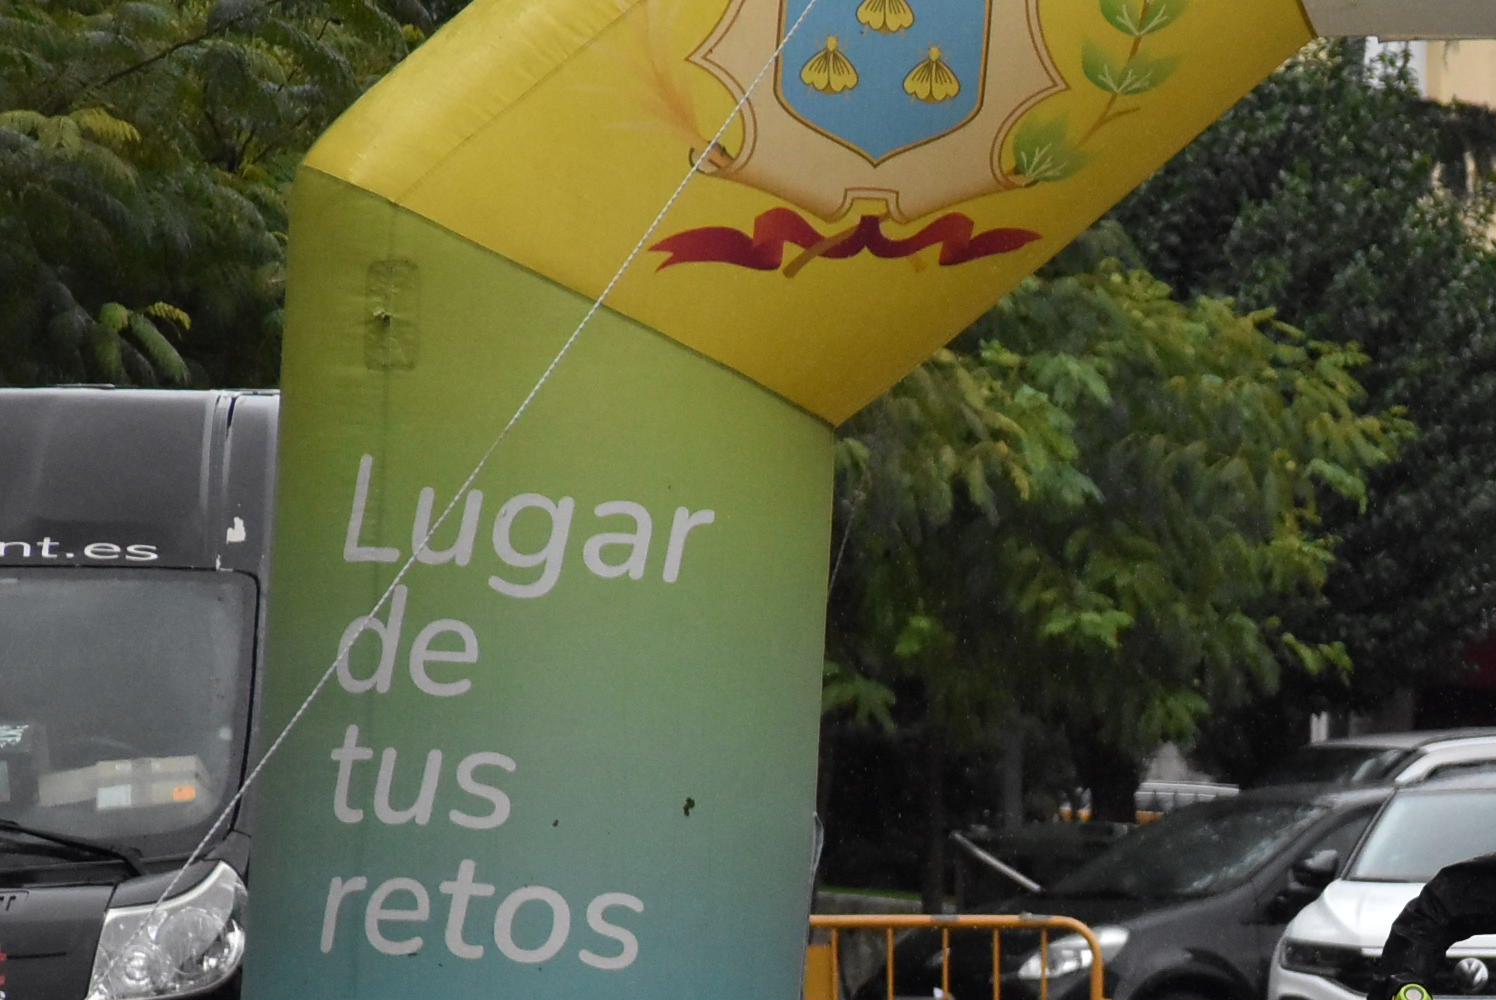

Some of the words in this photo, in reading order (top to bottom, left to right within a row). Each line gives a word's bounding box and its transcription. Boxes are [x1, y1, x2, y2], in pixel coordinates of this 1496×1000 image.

[343, 454, 714, 599] Lugar
[335, 585, 479, 697] de
[330, 725, 517, 830] tus
[320, 858, 645, 970] retos
